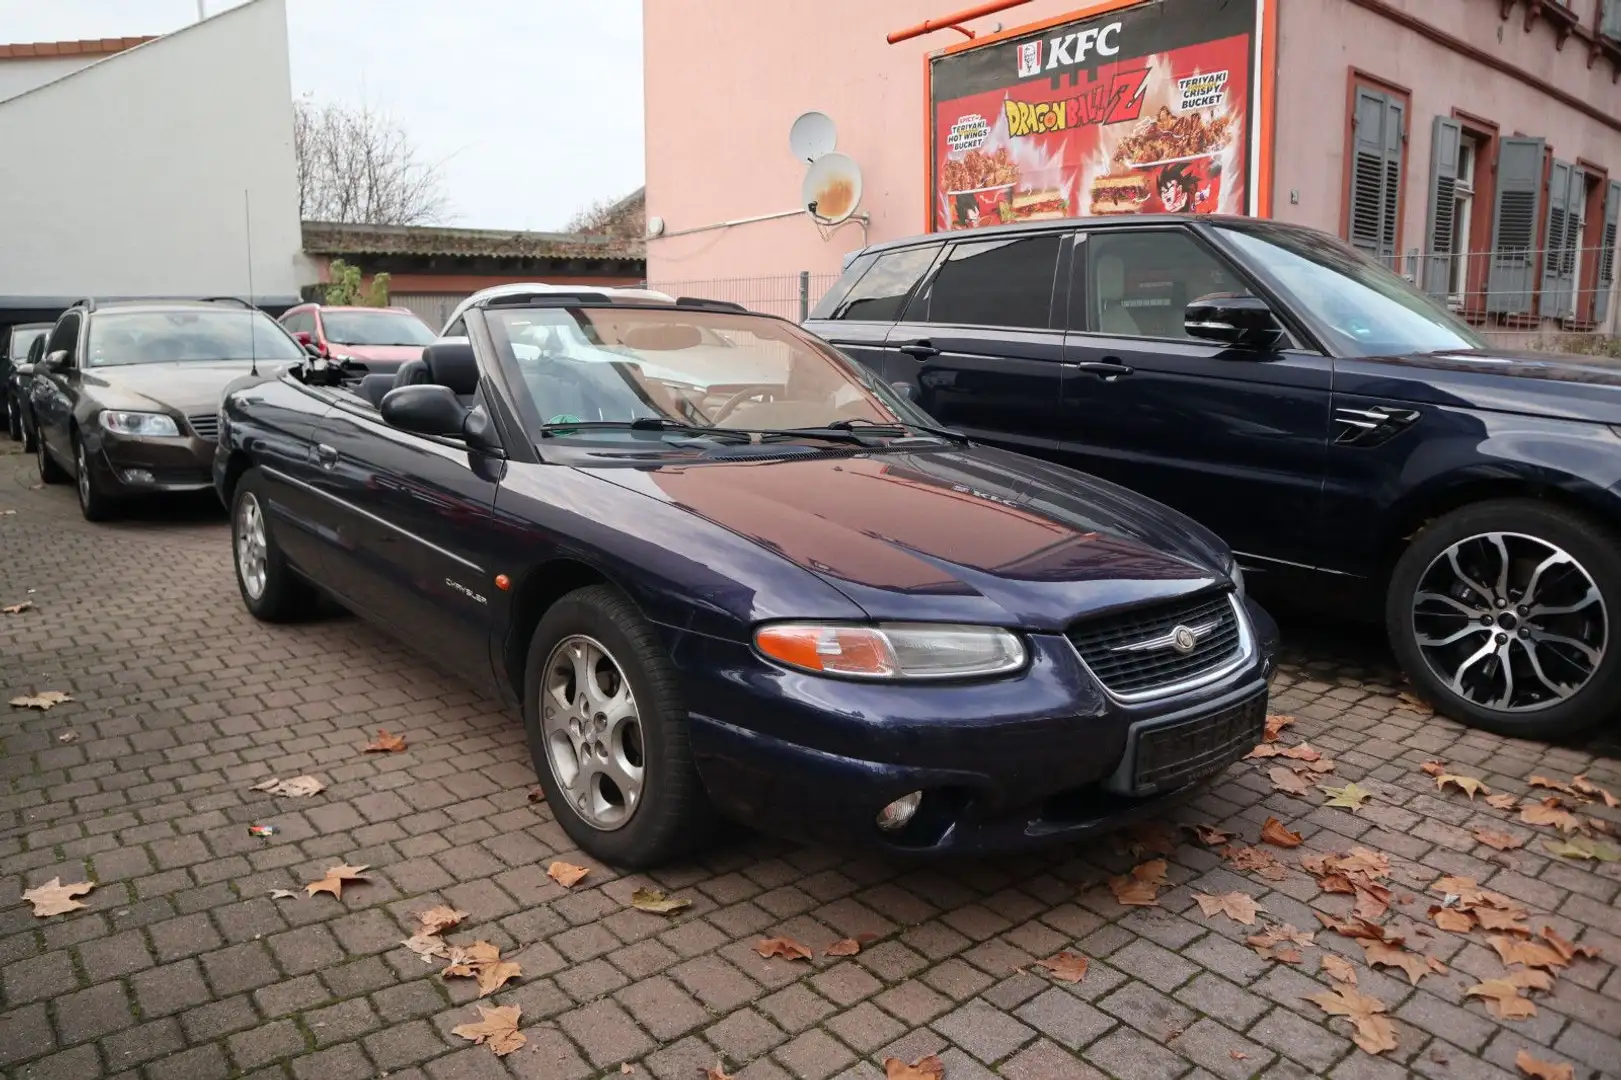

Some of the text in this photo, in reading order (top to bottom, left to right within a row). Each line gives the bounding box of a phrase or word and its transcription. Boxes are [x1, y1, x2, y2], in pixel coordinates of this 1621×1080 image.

[1045, 22, 1122, 70] KFC
[1180, 72, 1226, 89] TERIYAKI
[1183, 84, 1220, 98] CRISPY
[1005, 99, 1066, 138] DRAGON
[1103, 67, 1152, 125] Z
[1182, 94, 1222, 109] BUCKET
[952, 120, 985, 133] TERIYAKI
[948, 134, 963, 143] HOT
[964, 129, 988, 140] WINGS
[954, 139, 982, 150] BUCKET
